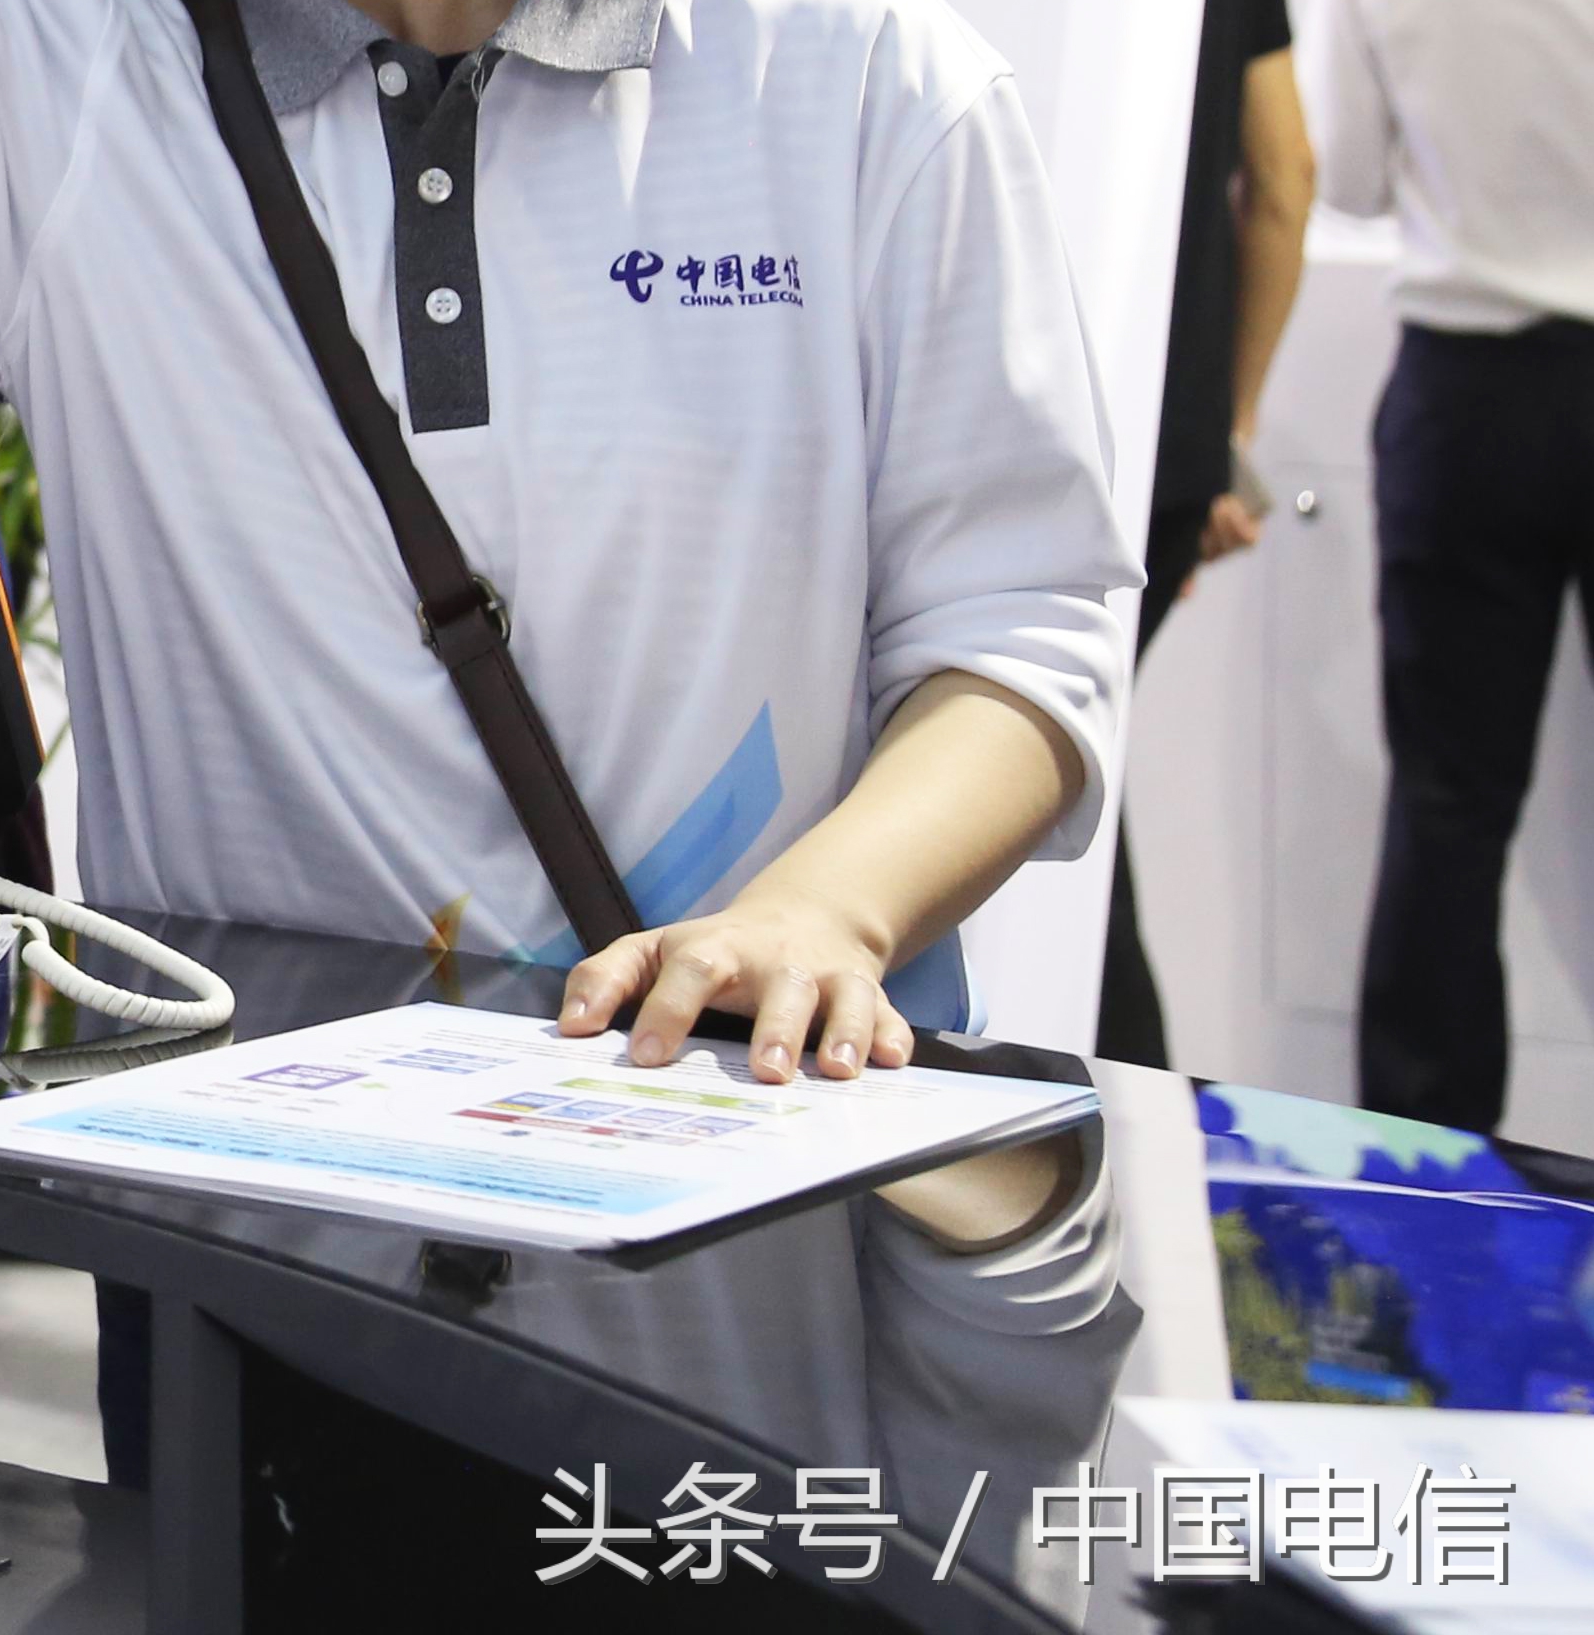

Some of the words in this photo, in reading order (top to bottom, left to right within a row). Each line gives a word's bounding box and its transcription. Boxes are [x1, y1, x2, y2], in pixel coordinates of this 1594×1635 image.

[676, 253, 801, 293] 中国电信
[680, 294, 734, 307] CHINA
